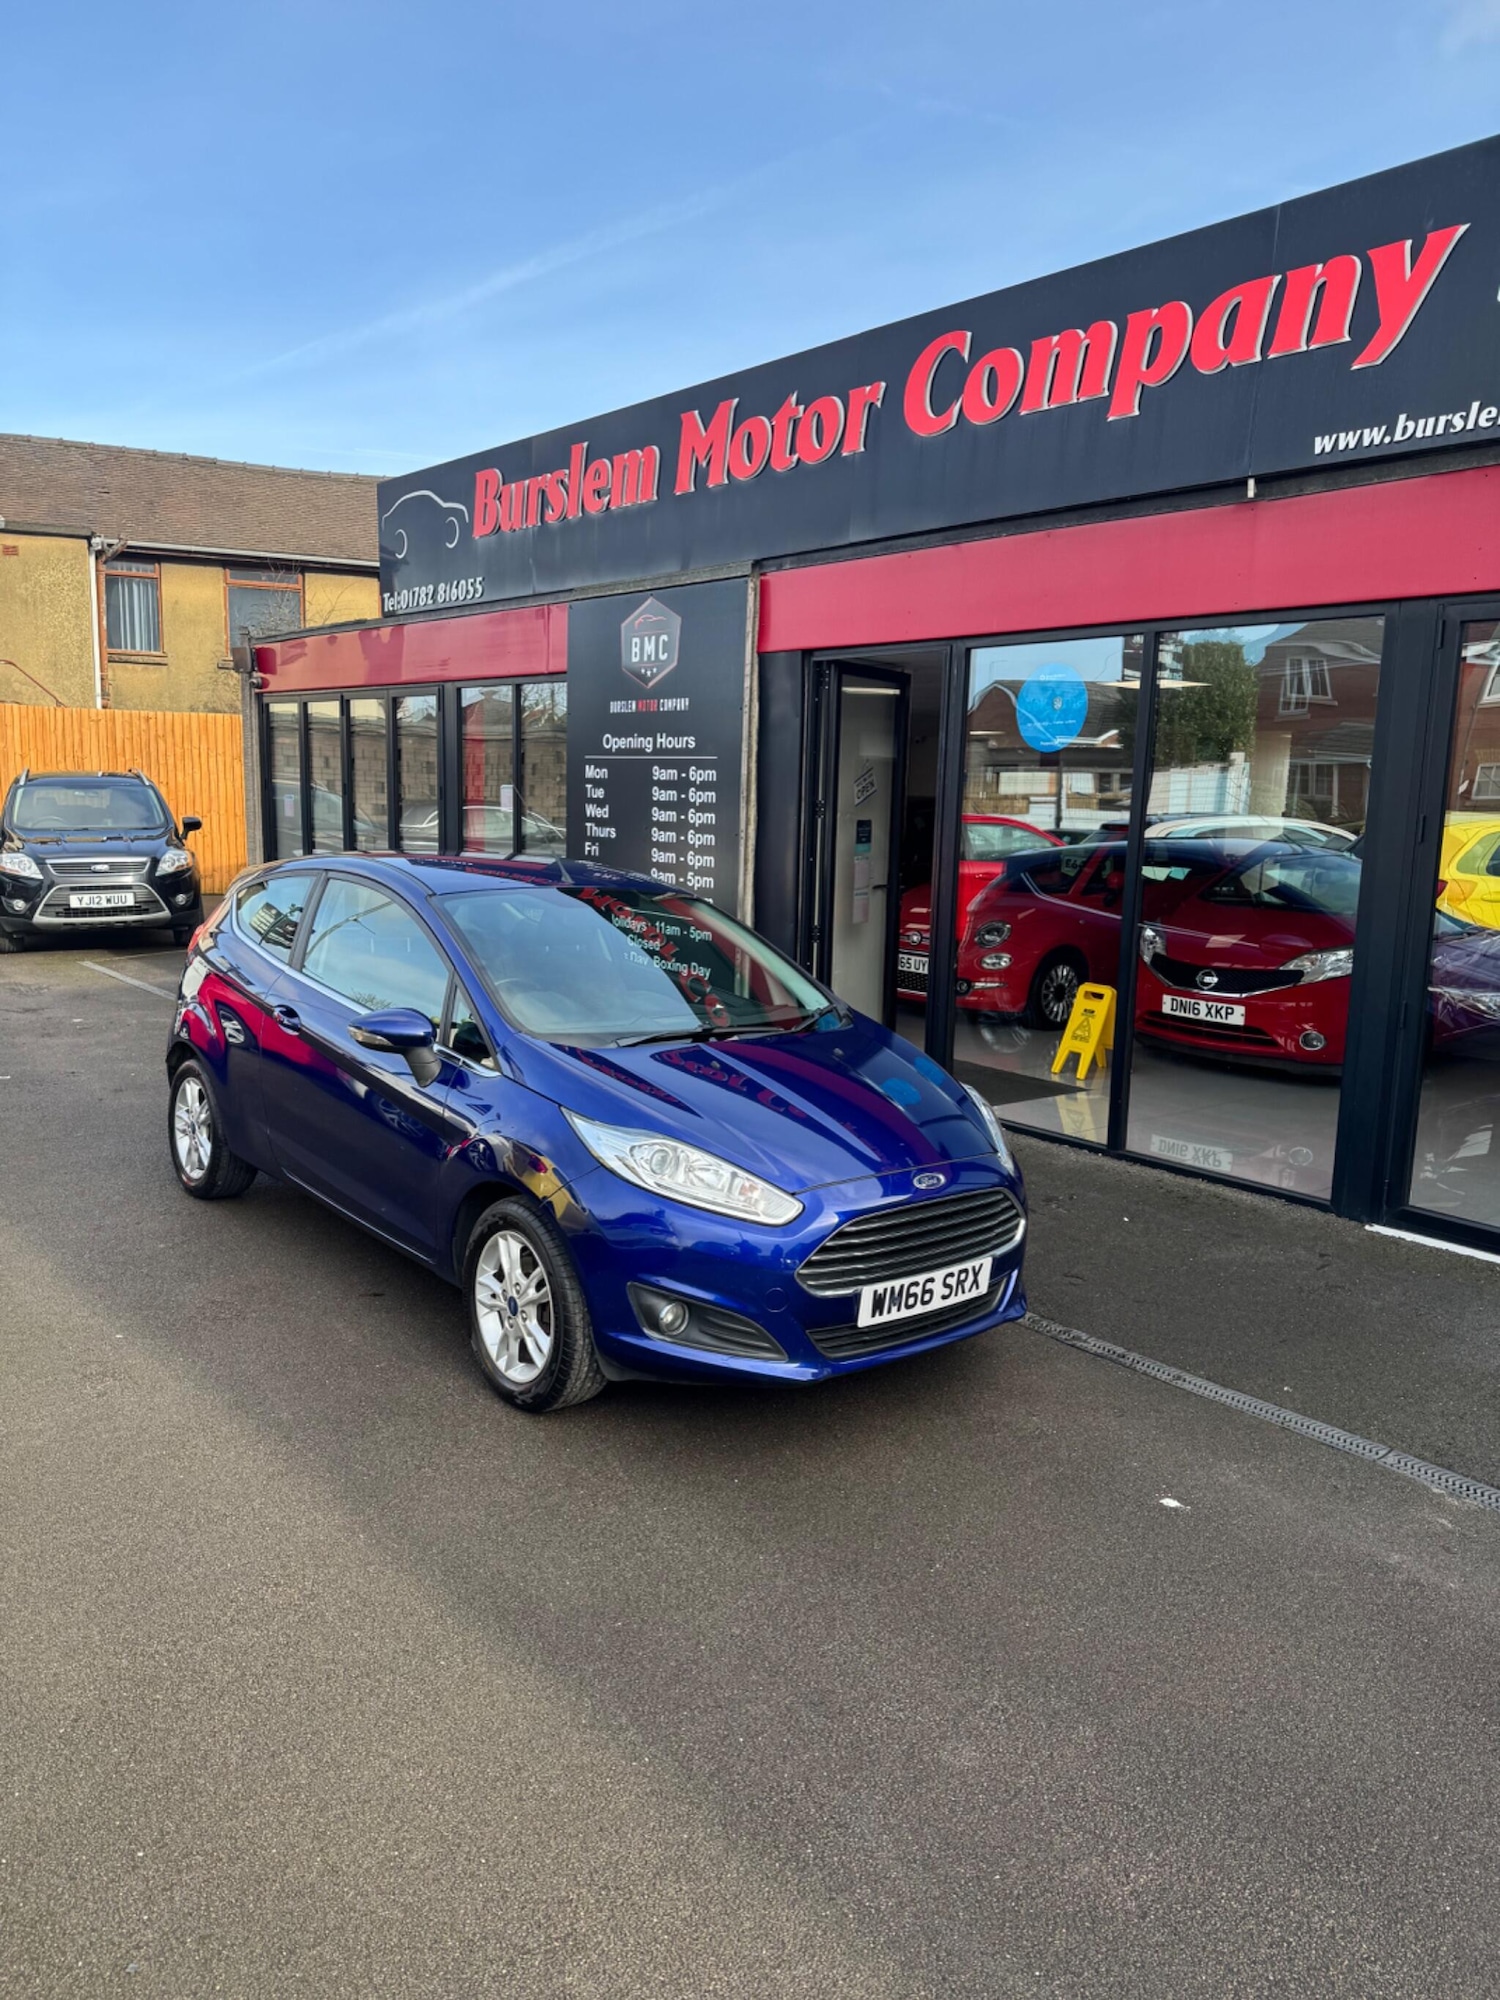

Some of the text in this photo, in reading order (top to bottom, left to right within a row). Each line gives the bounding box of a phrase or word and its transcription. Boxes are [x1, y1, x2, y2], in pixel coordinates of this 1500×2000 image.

[472, 223, 1471, 539] Burslem Motor Company
[1314, 400, 1500, 454] www.bursle
[383, 577, 483, 612] Tel:01782 816055
[631, 635, 669, 662] BMC
[602, 733, 696, 752] Opening Hours
[585, 765, 608, 779] Mon
[652, 766, 678, 780] 9am
[689, 766, 716, 784] 6pm
[585, 784, 605, 798] Tue
[652, 786, 677, 801] 9am
[688, 787, 716, 806] 6pm
[585, 803, 609, 818] Wed
[651, 807, 677, 822] 9am
[688, 808, 715, 827] 6pm
[585, 823, 616, 838] Thurs
[651, 827, 676, 843] 9am
[688, 829, 715, 848] 6pm
[585, 842, 599, 856] Fri
[651, 848, 676, 864] 9am
[687, 851, 714, 869] 6pm
[687, 872, 714, 890] 5pm
[77, 895, 102, 906] YJ12
[655, 921, 680, 936] 11am
[689, 926, 712, 942] 5pm
[653, 956, 688, 977] Boxing
[690, 962, 711, 980] Day
[1171, 998, 1234, 1020] DN16 XKP
[870, 1263, 983, 1318] WM66 SRX
